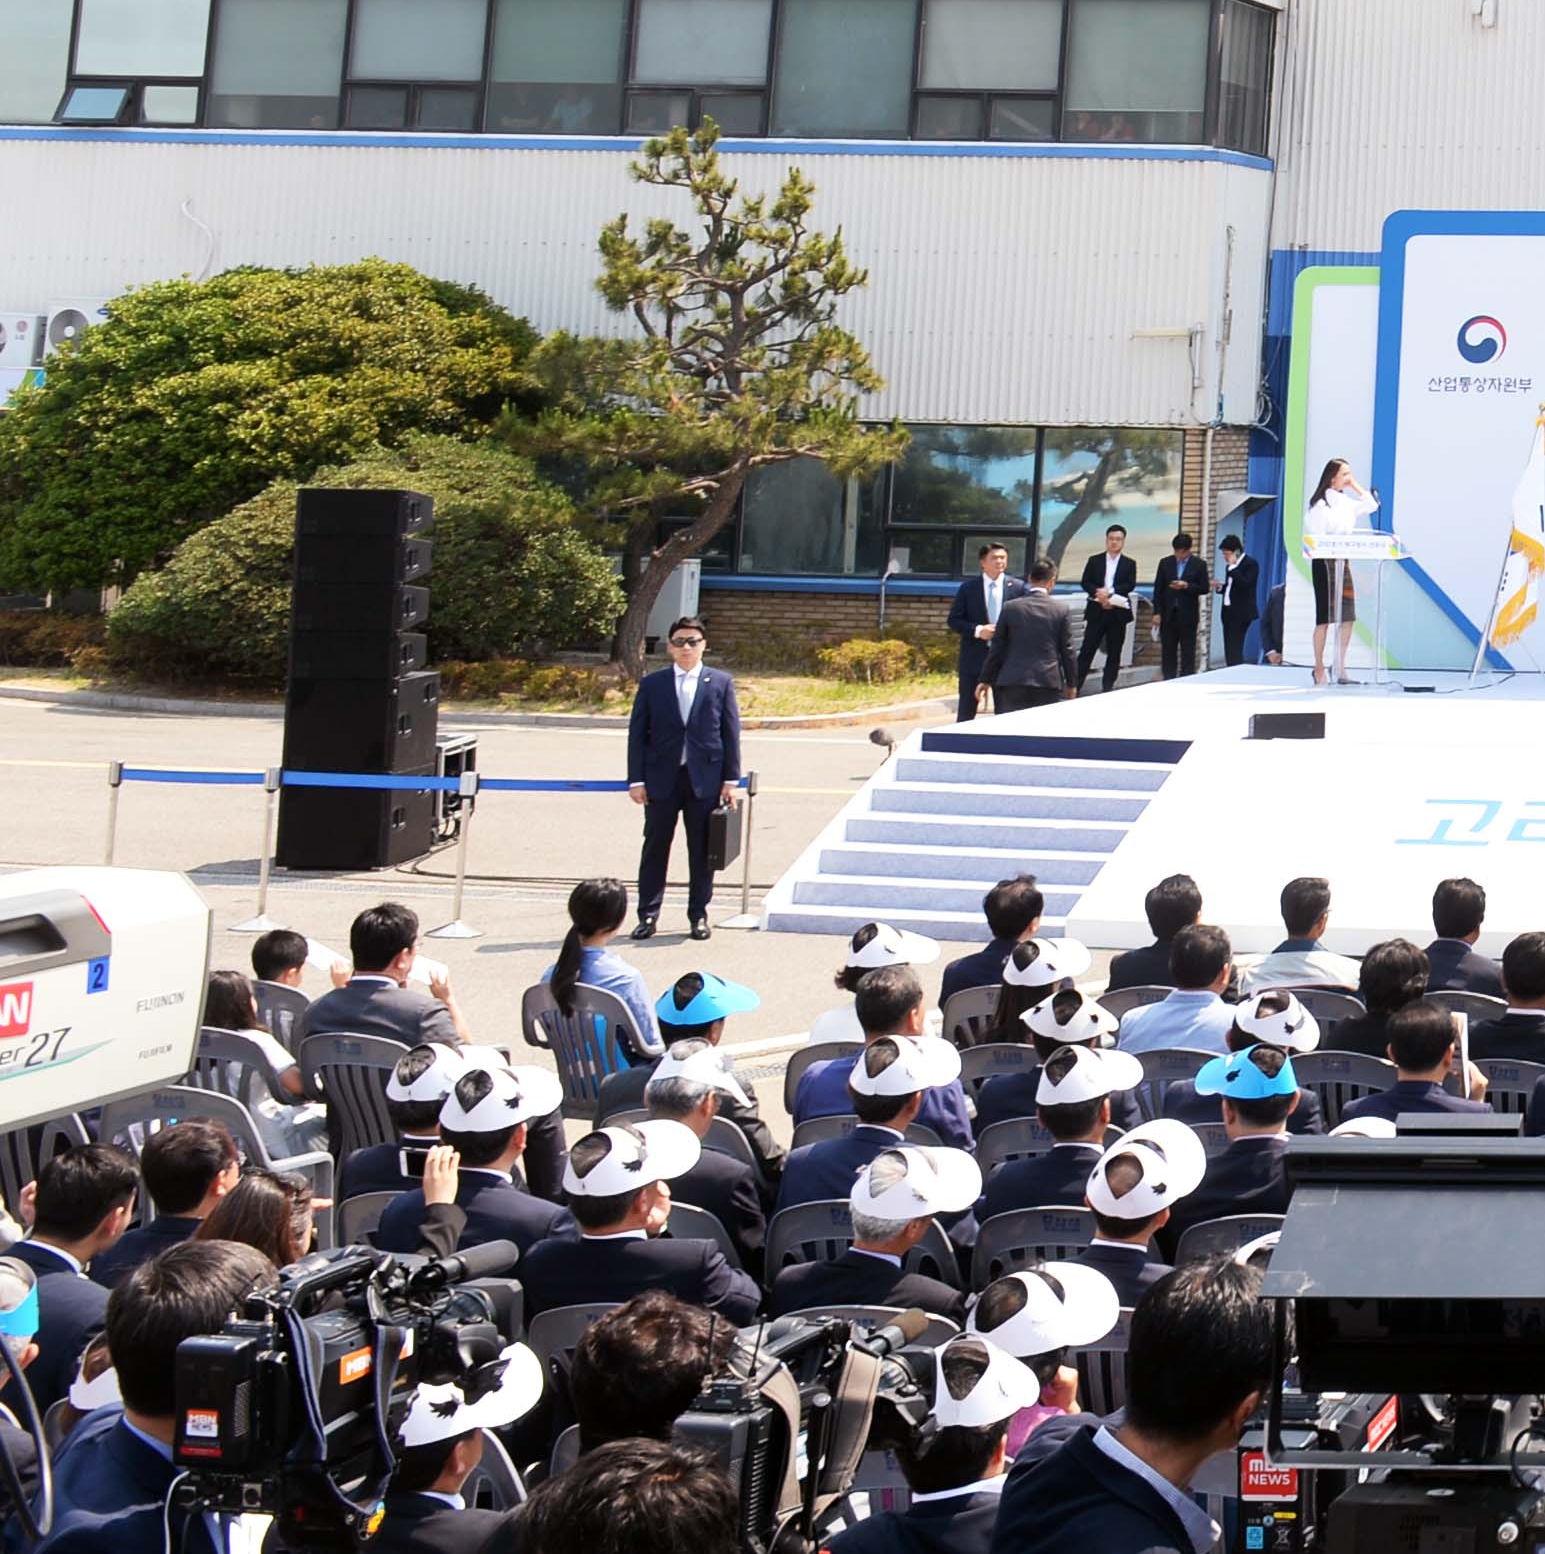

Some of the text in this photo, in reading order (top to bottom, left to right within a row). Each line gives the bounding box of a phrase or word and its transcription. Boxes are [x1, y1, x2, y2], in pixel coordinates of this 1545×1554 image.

[1428, 376, 1533, 394] 산업통상자원부
[92, 963, 105, 990] 2
[1249, 1473, 1291, 1486] NEWS
